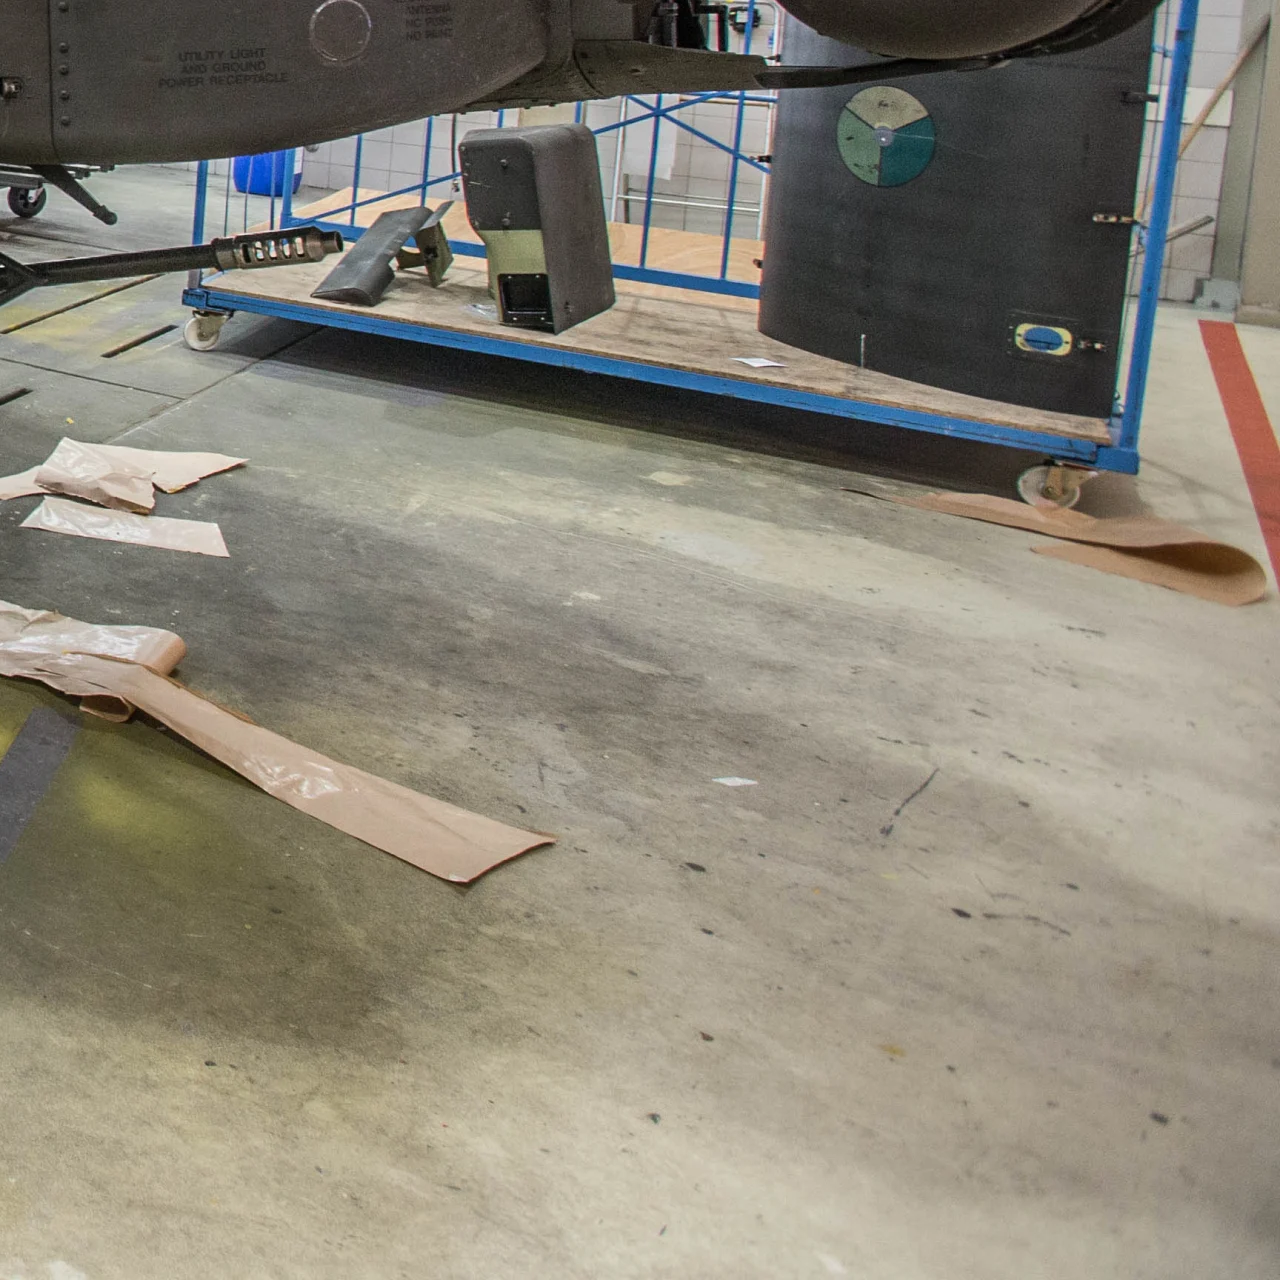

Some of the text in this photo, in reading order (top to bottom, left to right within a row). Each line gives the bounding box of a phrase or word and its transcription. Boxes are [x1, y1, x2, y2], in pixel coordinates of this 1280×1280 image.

[178, 48, 266, 62] UTILITY LIGHT
[181, 60, 266, 74] AND GROUND
[158, 72, 288, 88] POWER RECEPTACLE
